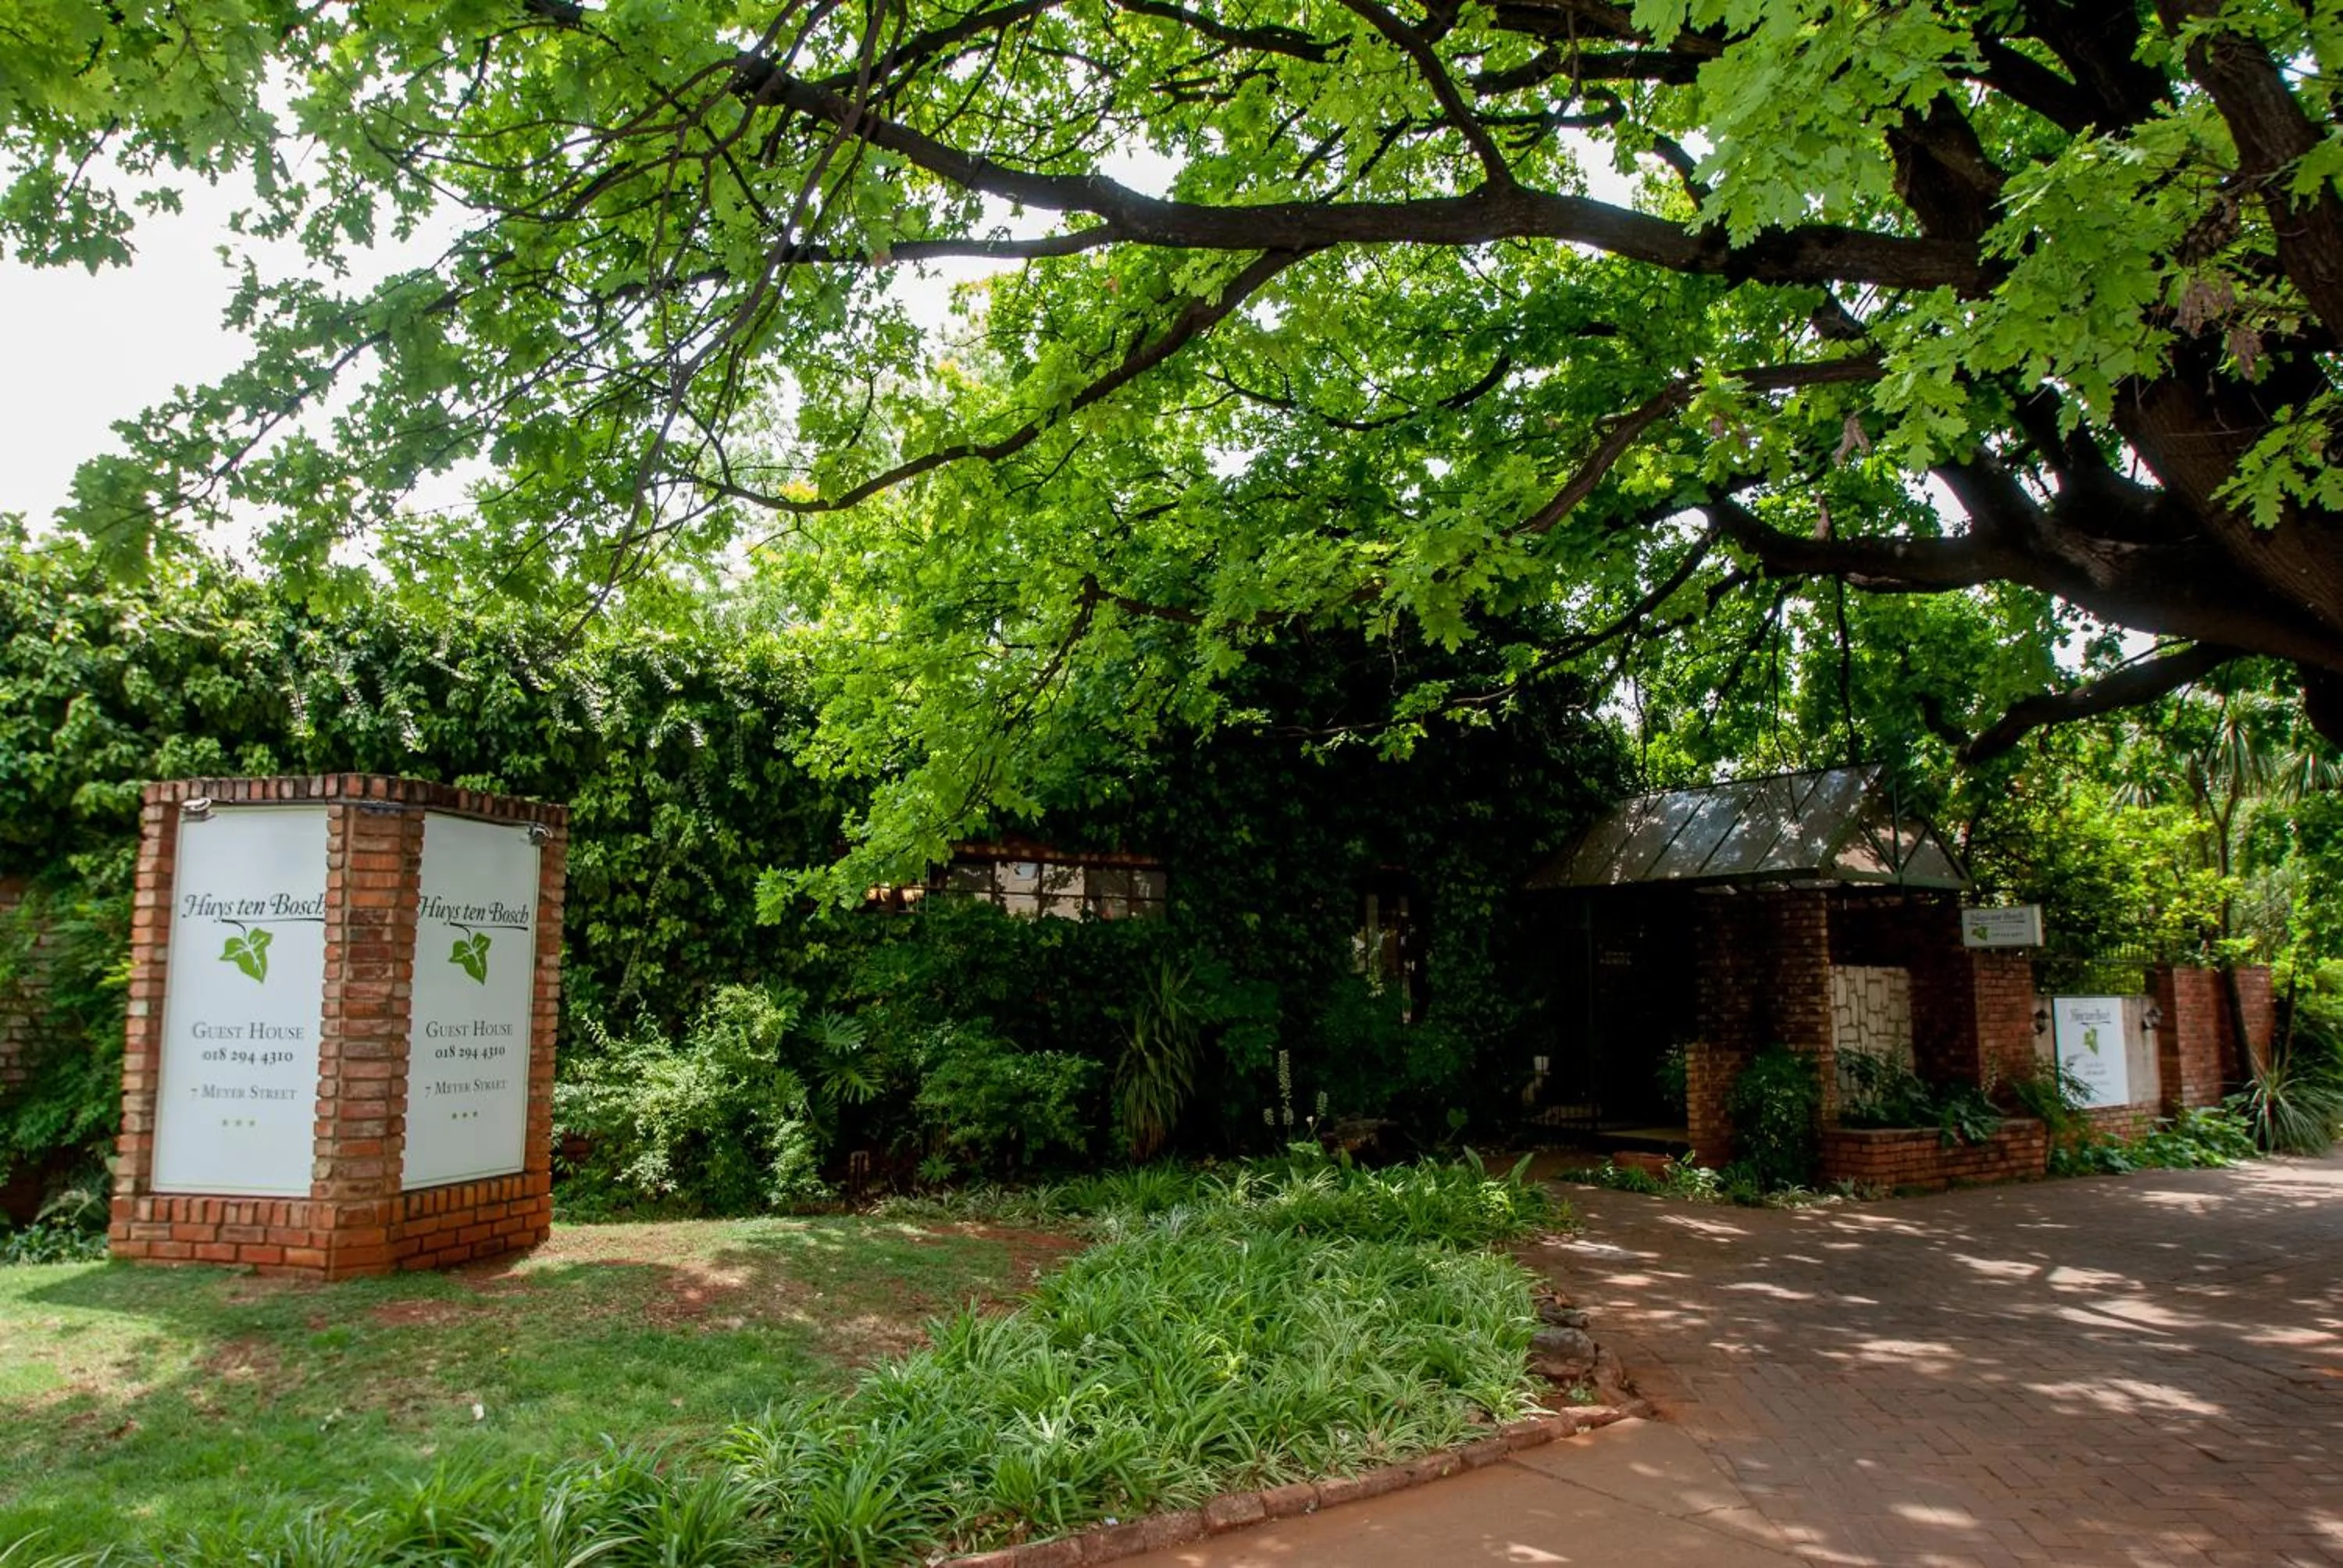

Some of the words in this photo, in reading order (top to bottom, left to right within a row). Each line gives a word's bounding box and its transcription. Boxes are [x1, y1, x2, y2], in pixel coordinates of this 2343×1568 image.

[181, 893, 234, 922] Huys
[239, 894, 266, 915] ten
[420, 895, 462, 925] Huys
[464, 903, 486, 921] ten
[488, 901, 530, 925] Bosch
[201, 1047, 226, 1061] 018
[230, 1049, 255, 1065] 294
[260, 1051, 294, 1066] 4310
[435, 1045, 455, 1060] 018
[458, 1047, 478, 1060] 294
[480, 1046, 505, 1060] 4310
[425, 1085, 431, 1099] 7
